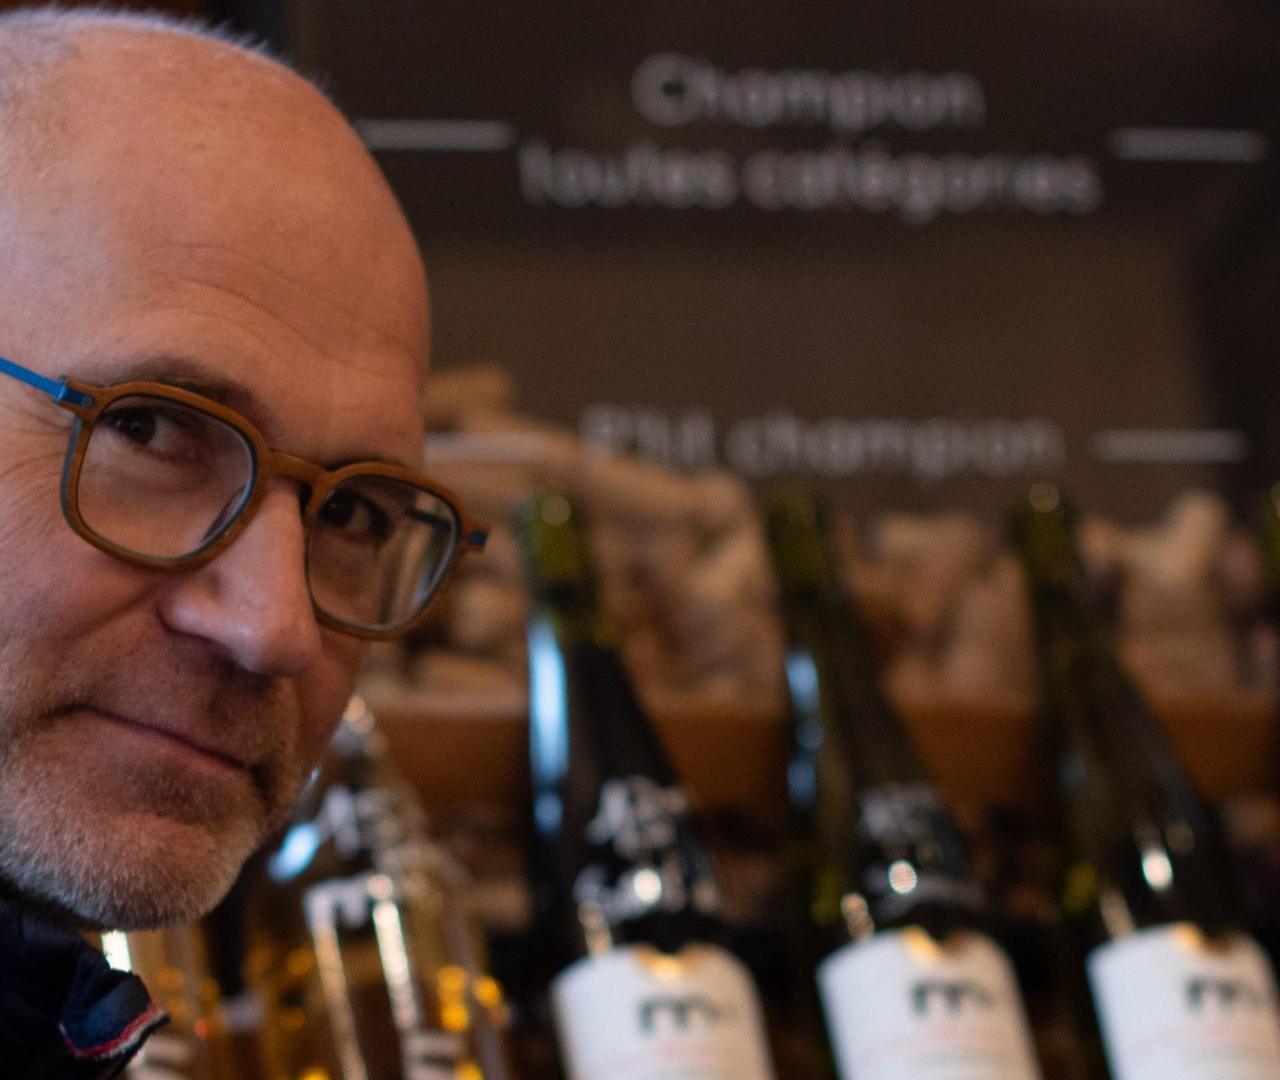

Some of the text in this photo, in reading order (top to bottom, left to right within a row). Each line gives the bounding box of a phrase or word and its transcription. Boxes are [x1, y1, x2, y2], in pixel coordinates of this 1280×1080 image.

[631, 52, 984, 130] Champion
[520, 143, 1102, 222] toutes catégories
[728, 410, 1062, 477] champion
